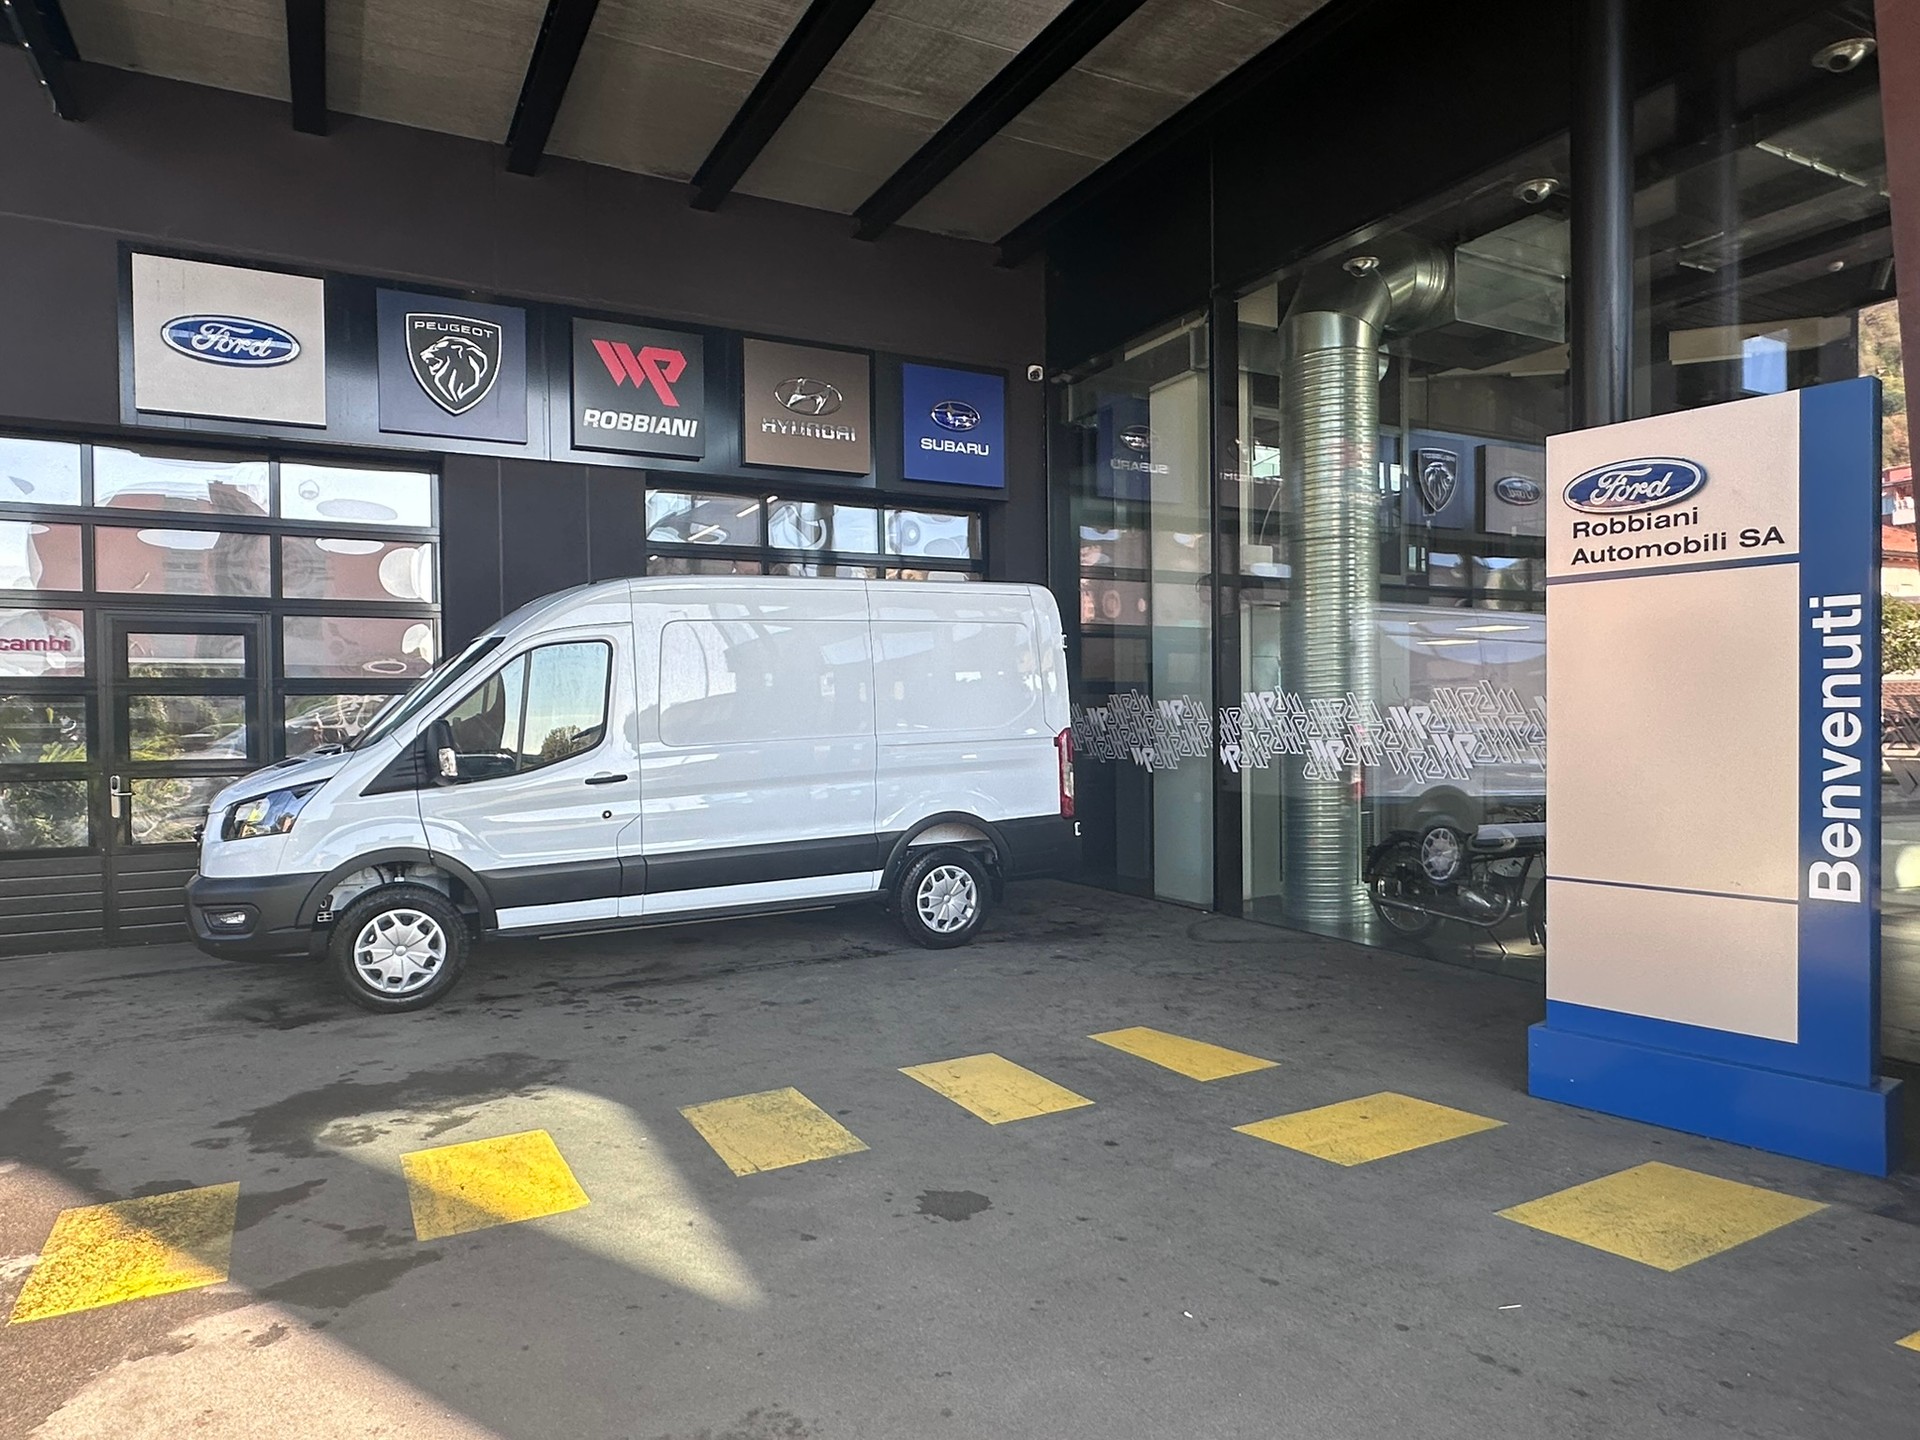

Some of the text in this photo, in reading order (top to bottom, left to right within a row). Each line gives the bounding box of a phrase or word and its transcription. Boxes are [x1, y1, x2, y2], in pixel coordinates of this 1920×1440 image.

[191, 323, 272, 357] Ford
[414, 320, 494, 338] PEUGEOT
[583, 408, 698, 438] ROBBIANI
[761, 417, 856, 442] HYUNDAI
[920, 437, 989, 456] SUBARU
[1590, 467, 1674, 505] Ford
[1572, 507, 1698, 539] Robbiani
[1571, 526, 1785, 566] Automobili SA
[1808, 594, 1863, 903] Benvenuti
